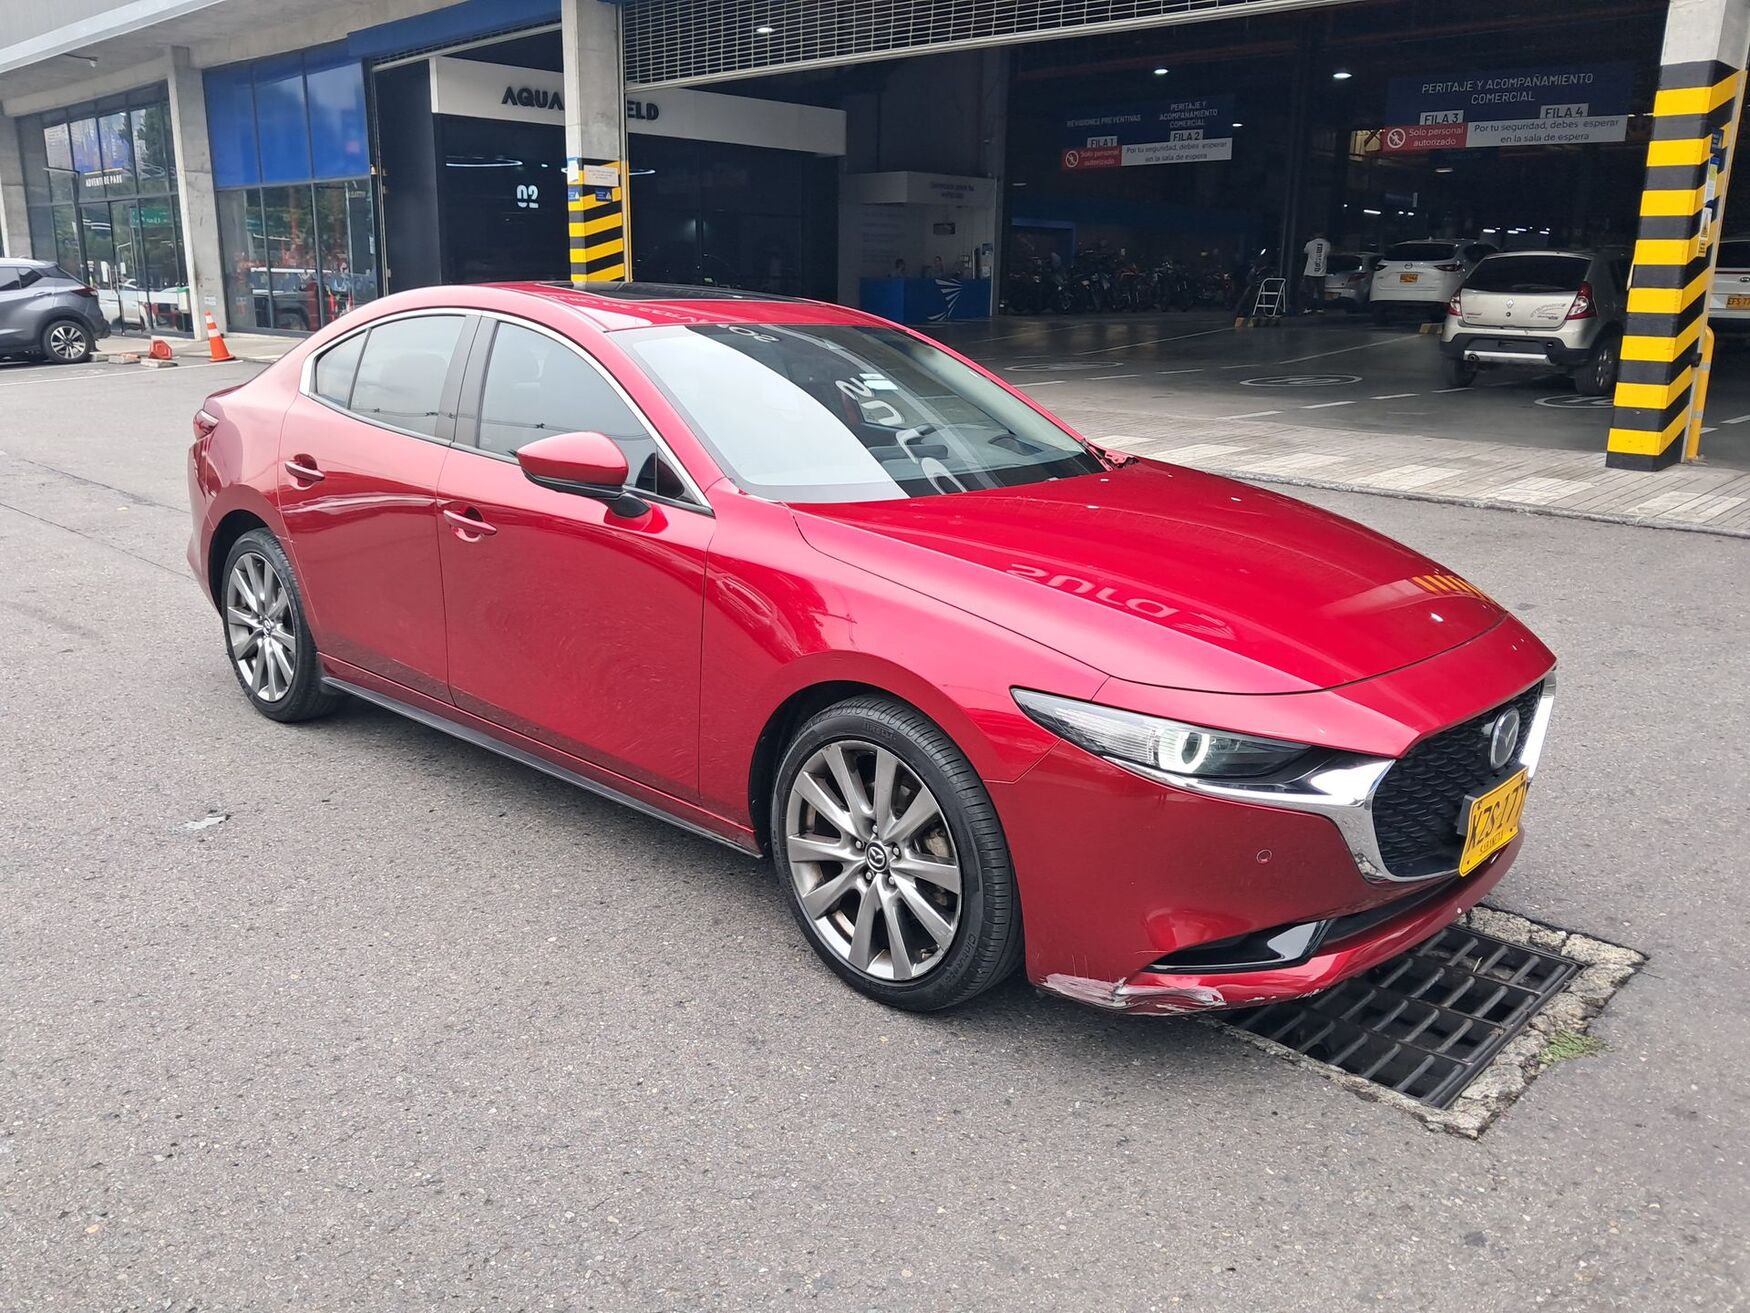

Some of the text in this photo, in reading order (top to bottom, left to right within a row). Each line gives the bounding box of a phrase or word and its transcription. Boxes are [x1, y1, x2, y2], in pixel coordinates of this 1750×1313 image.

[1421, 73, 1594, 94] PERITAJE Y ACOMPAÑAMIENTO
[1471, 91, 1536, 105] COMERCIAL
[627, 101, 659, 121] ELD
[1545, 106, 1584, 119] FILA 4
[1424, 113, 1459, 125] FILA 3
[1474, 124, 1489, 132] Por
[1490, 123, 1499, 131] tu
[1550, 120, 1579, 129] debes
[1583, 119, 1620, 129] esperar
[1173, 131, 1200, 142] FILA 2
[1408, 126, 1464, 137] Solo personal
[1500, 132, 1590, 143] en la sala de espera
[1090, 138, 1108, 148] FILA
[516, 184, 539, 208] 02
